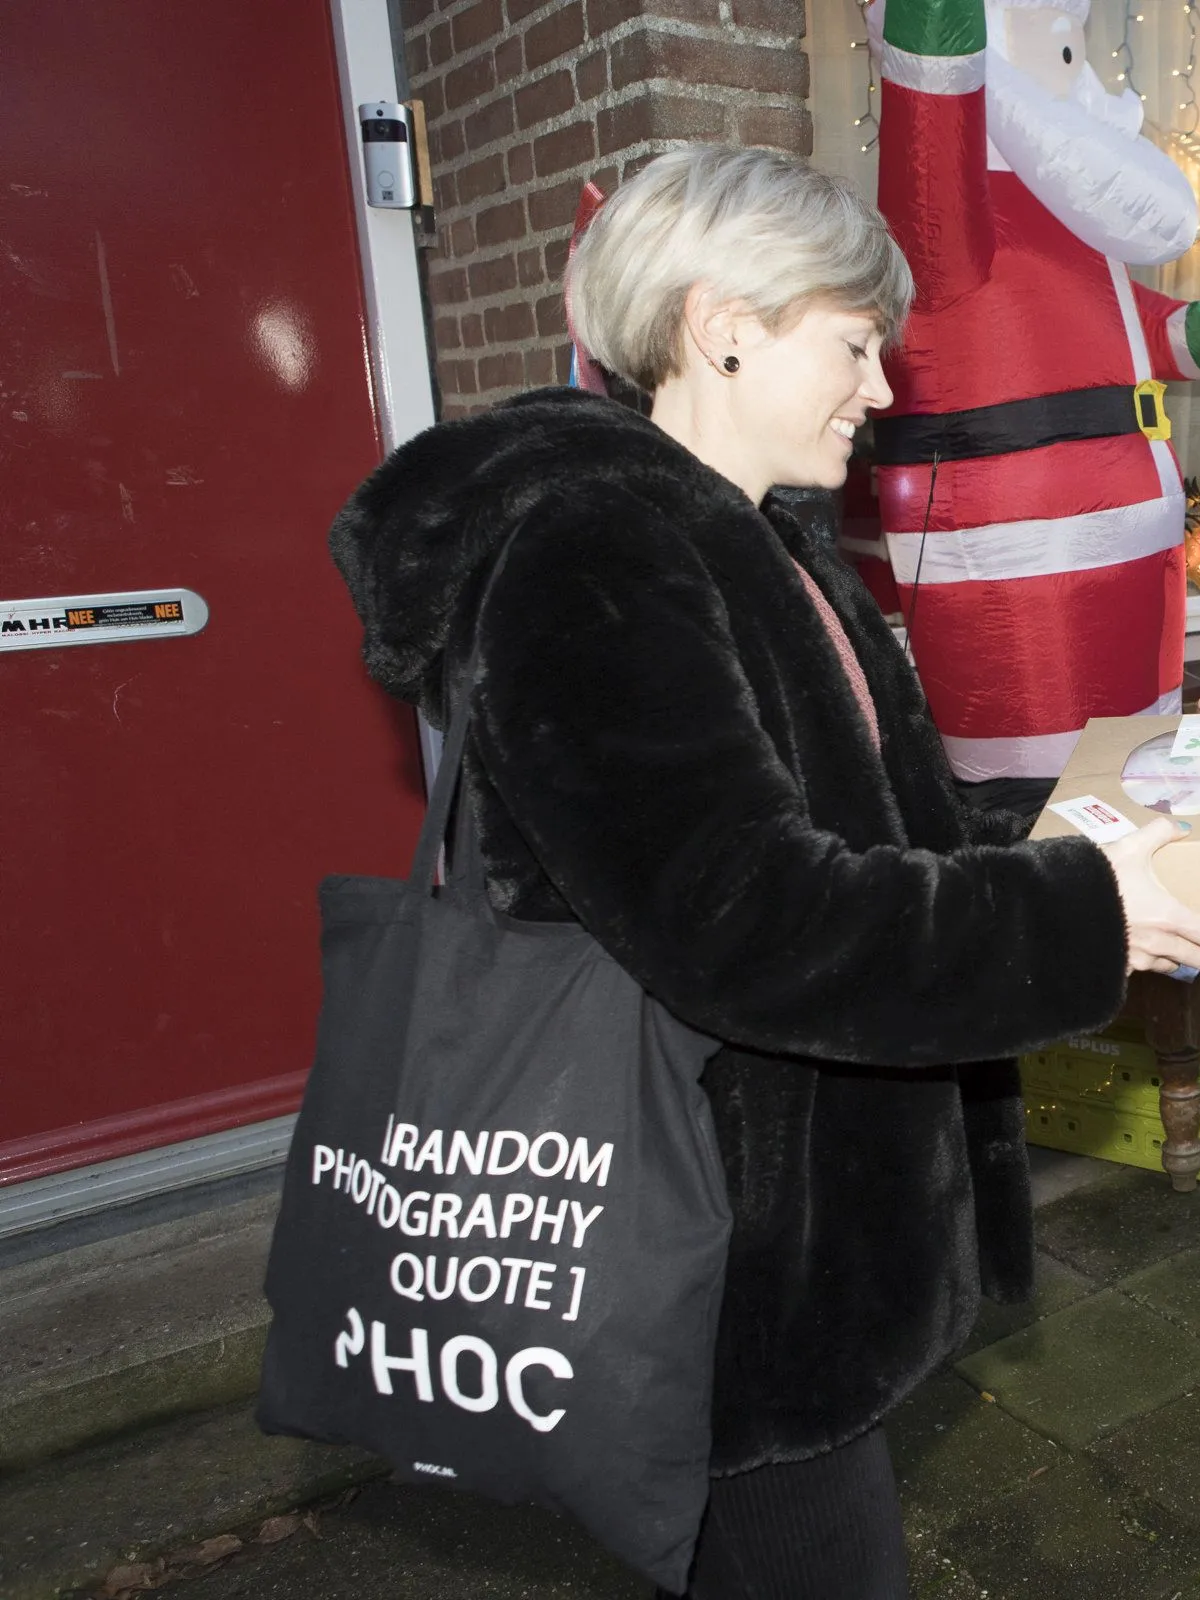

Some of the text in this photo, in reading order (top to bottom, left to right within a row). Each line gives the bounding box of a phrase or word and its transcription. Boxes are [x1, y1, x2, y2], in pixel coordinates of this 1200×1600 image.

[68, 610, 95, 625] NEE
[155, 603, 180, 619] NEE
[1081, 1038, 1120, 1055] PLUS
[312, 1144, 604, 1248] PHOTOGRAPHY
